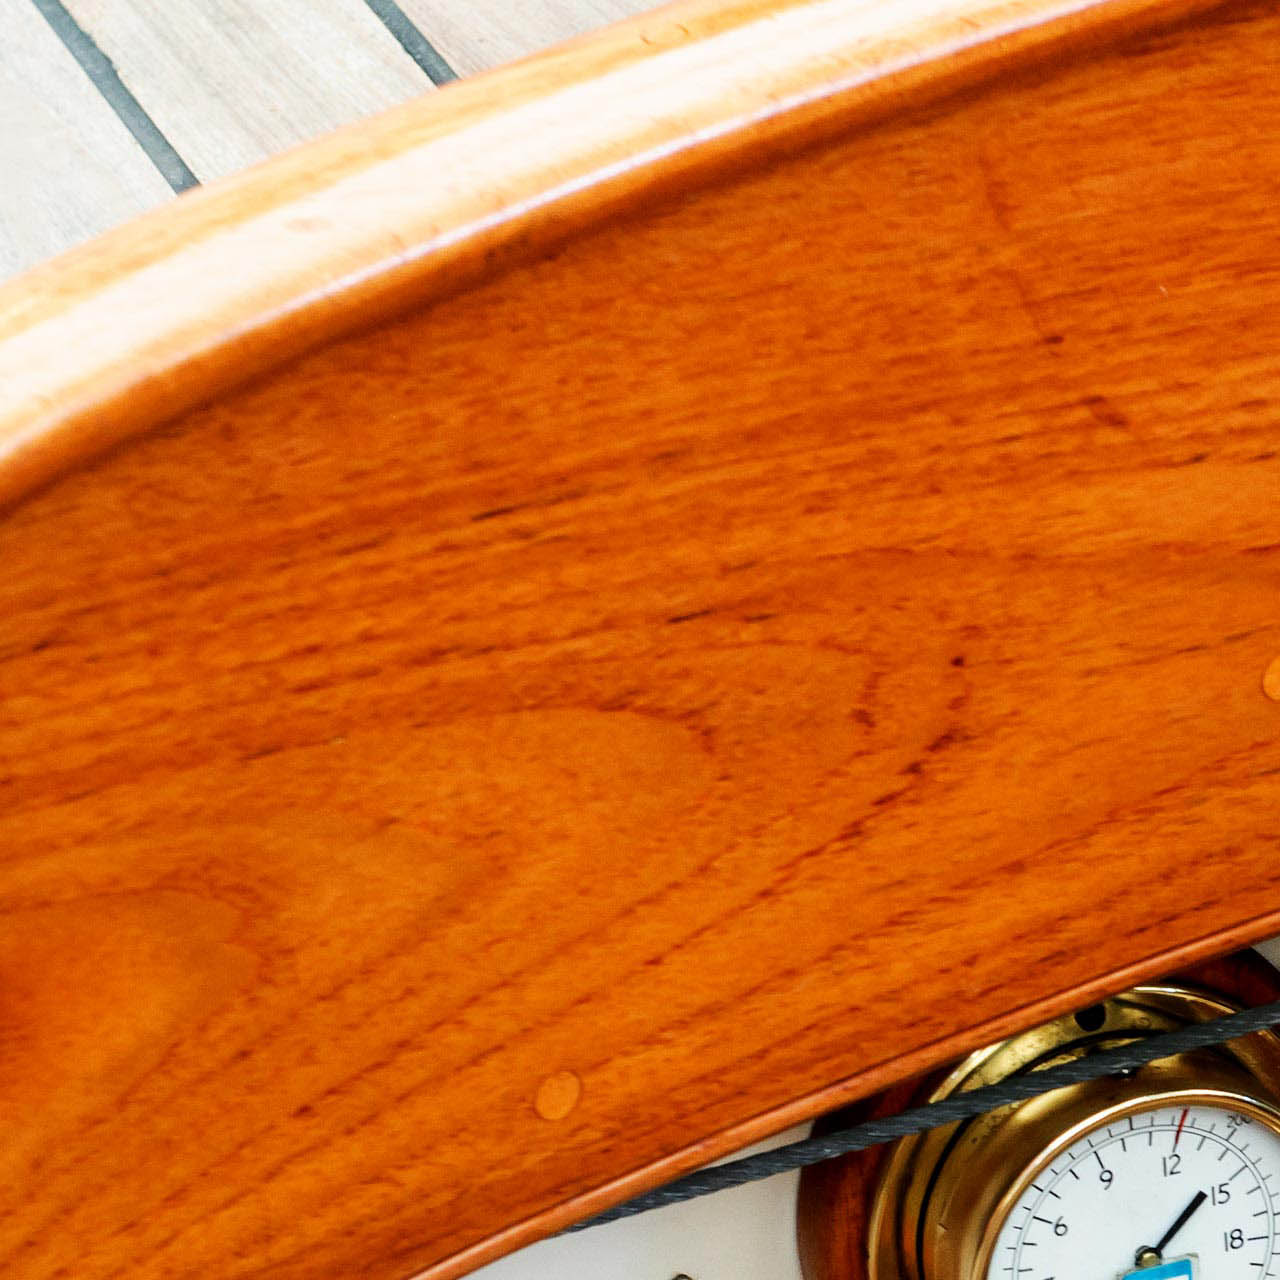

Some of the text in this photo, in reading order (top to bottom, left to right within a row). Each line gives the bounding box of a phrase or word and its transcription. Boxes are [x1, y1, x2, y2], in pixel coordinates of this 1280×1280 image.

[1162, 1153, 1181, 1177] 12
[1100, 1169, 1113, 1191] 9
[1211, 1182, 1231, 1207] 15
[1054, 1216, 1068, 1236] 6
[1224, 1228, 1244, 1252] 18
